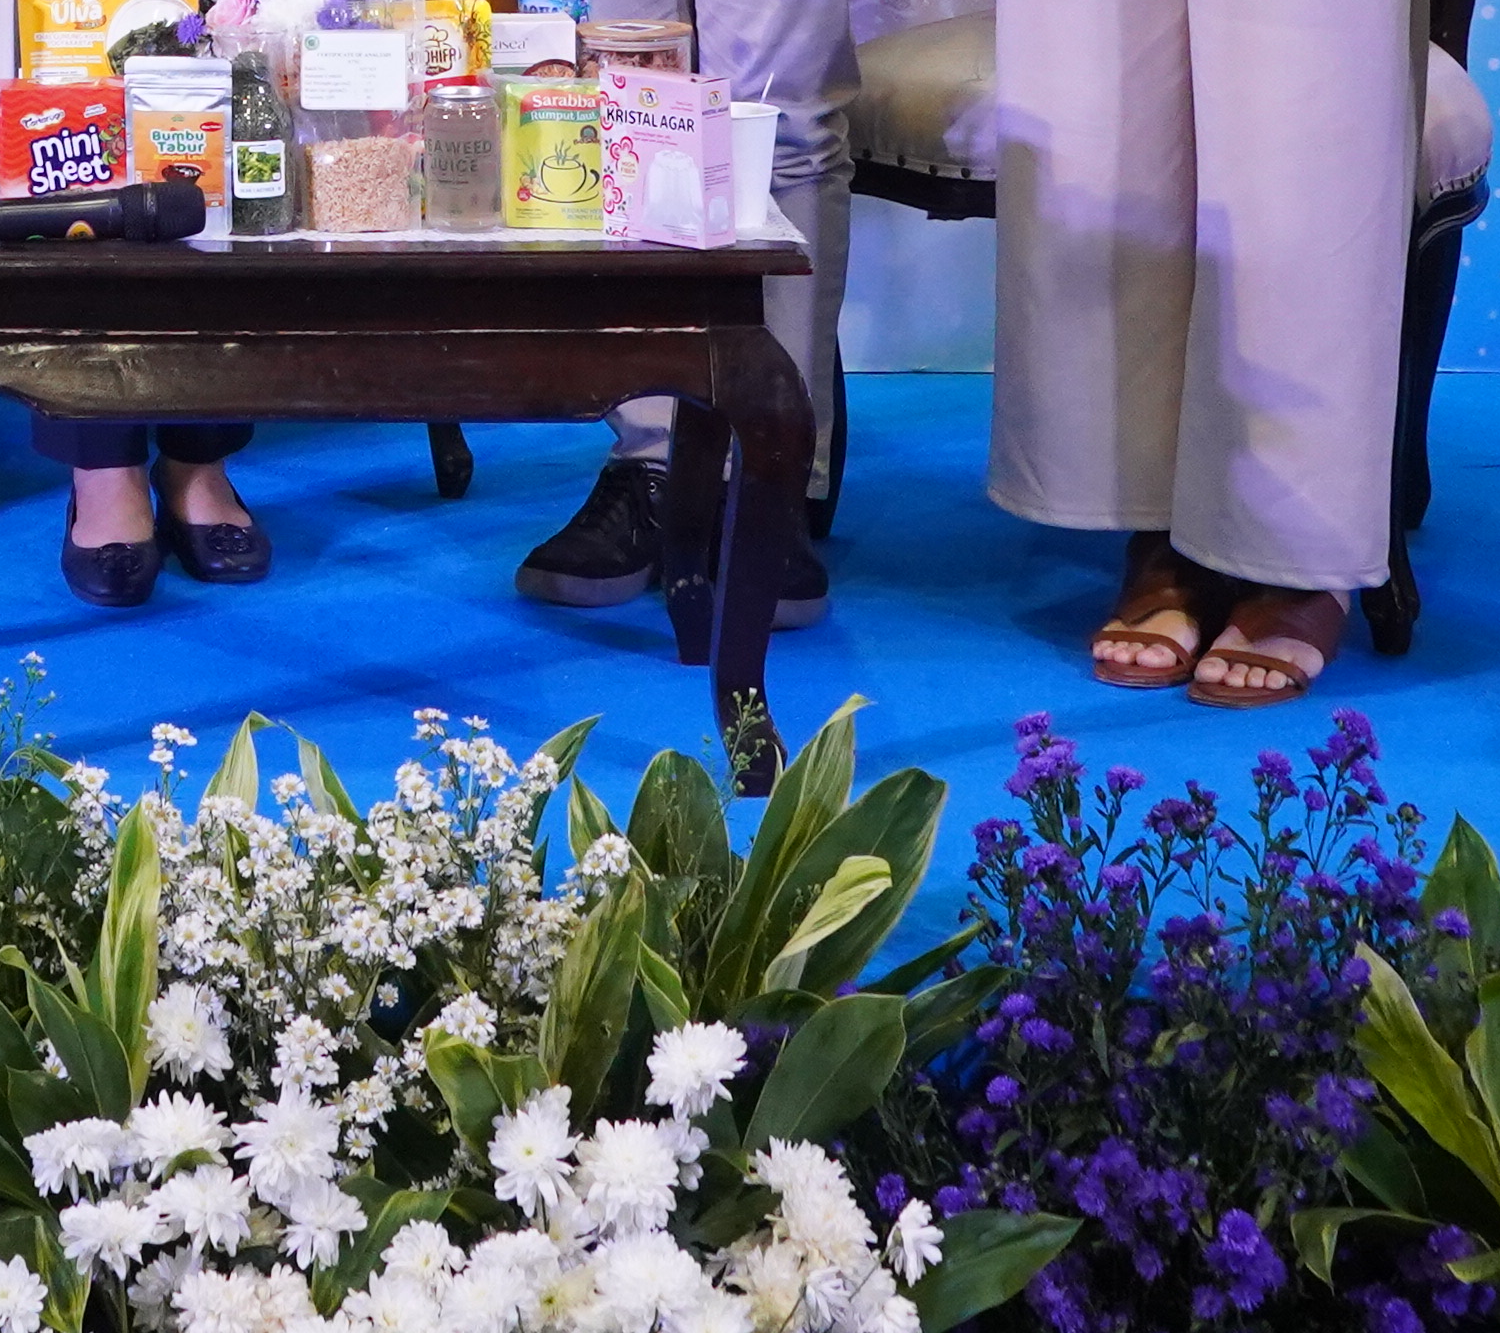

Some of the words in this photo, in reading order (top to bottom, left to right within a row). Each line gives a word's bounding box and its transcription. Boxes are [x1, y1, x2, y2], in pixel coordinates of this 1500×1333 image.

[51, 0, 103, 25] Ulva
[532, 93, 597, 108] Sarabba
[531, 111, 574, 122] Rumput
[606, 107, 658, 128] KRISTAL
[660, 115, 695, 133] AGAR
[31, 125, 101, 167] mini
[152, 131, 205, 141] Bumbu
[157, 141, 205, 153] Tabur
[30, 155, 111, 194] sheet
